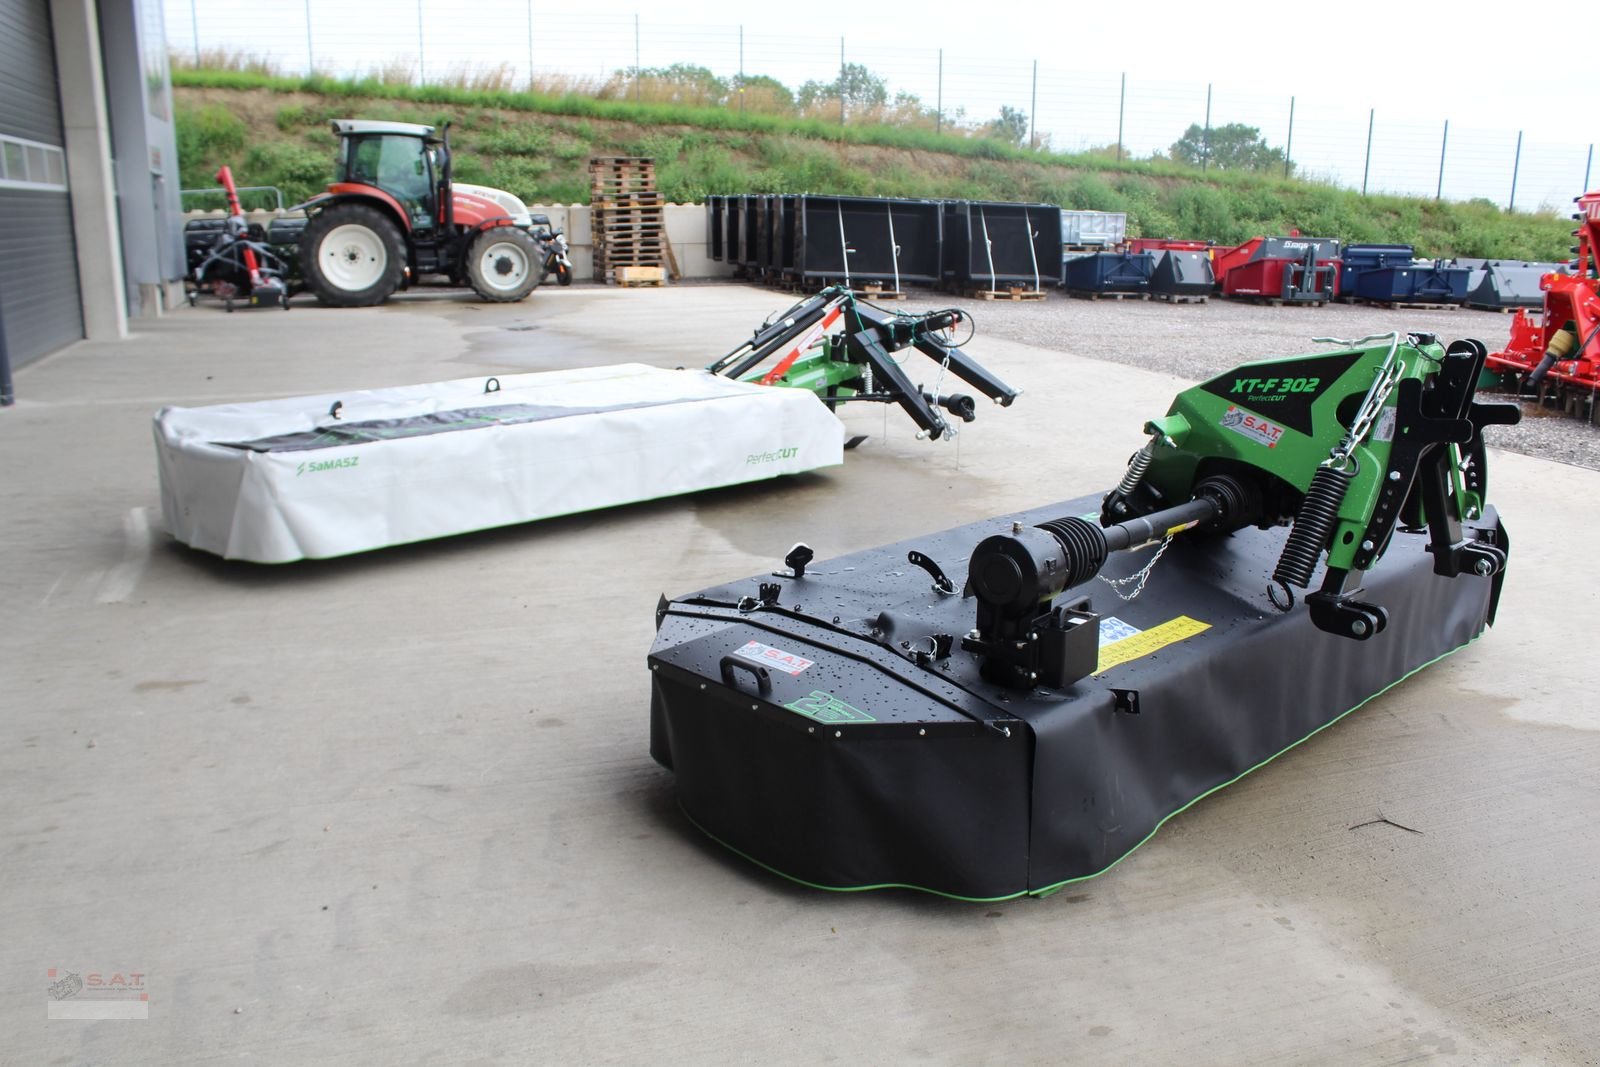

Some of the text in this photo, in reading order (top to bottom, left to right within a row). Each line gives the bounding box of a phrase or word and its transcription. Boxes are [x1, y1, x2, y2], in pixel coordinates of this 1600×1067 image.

[1230, 378, 1320, 393] XT-F 302
[1243, 415, 1282, 439] S.A.T.
